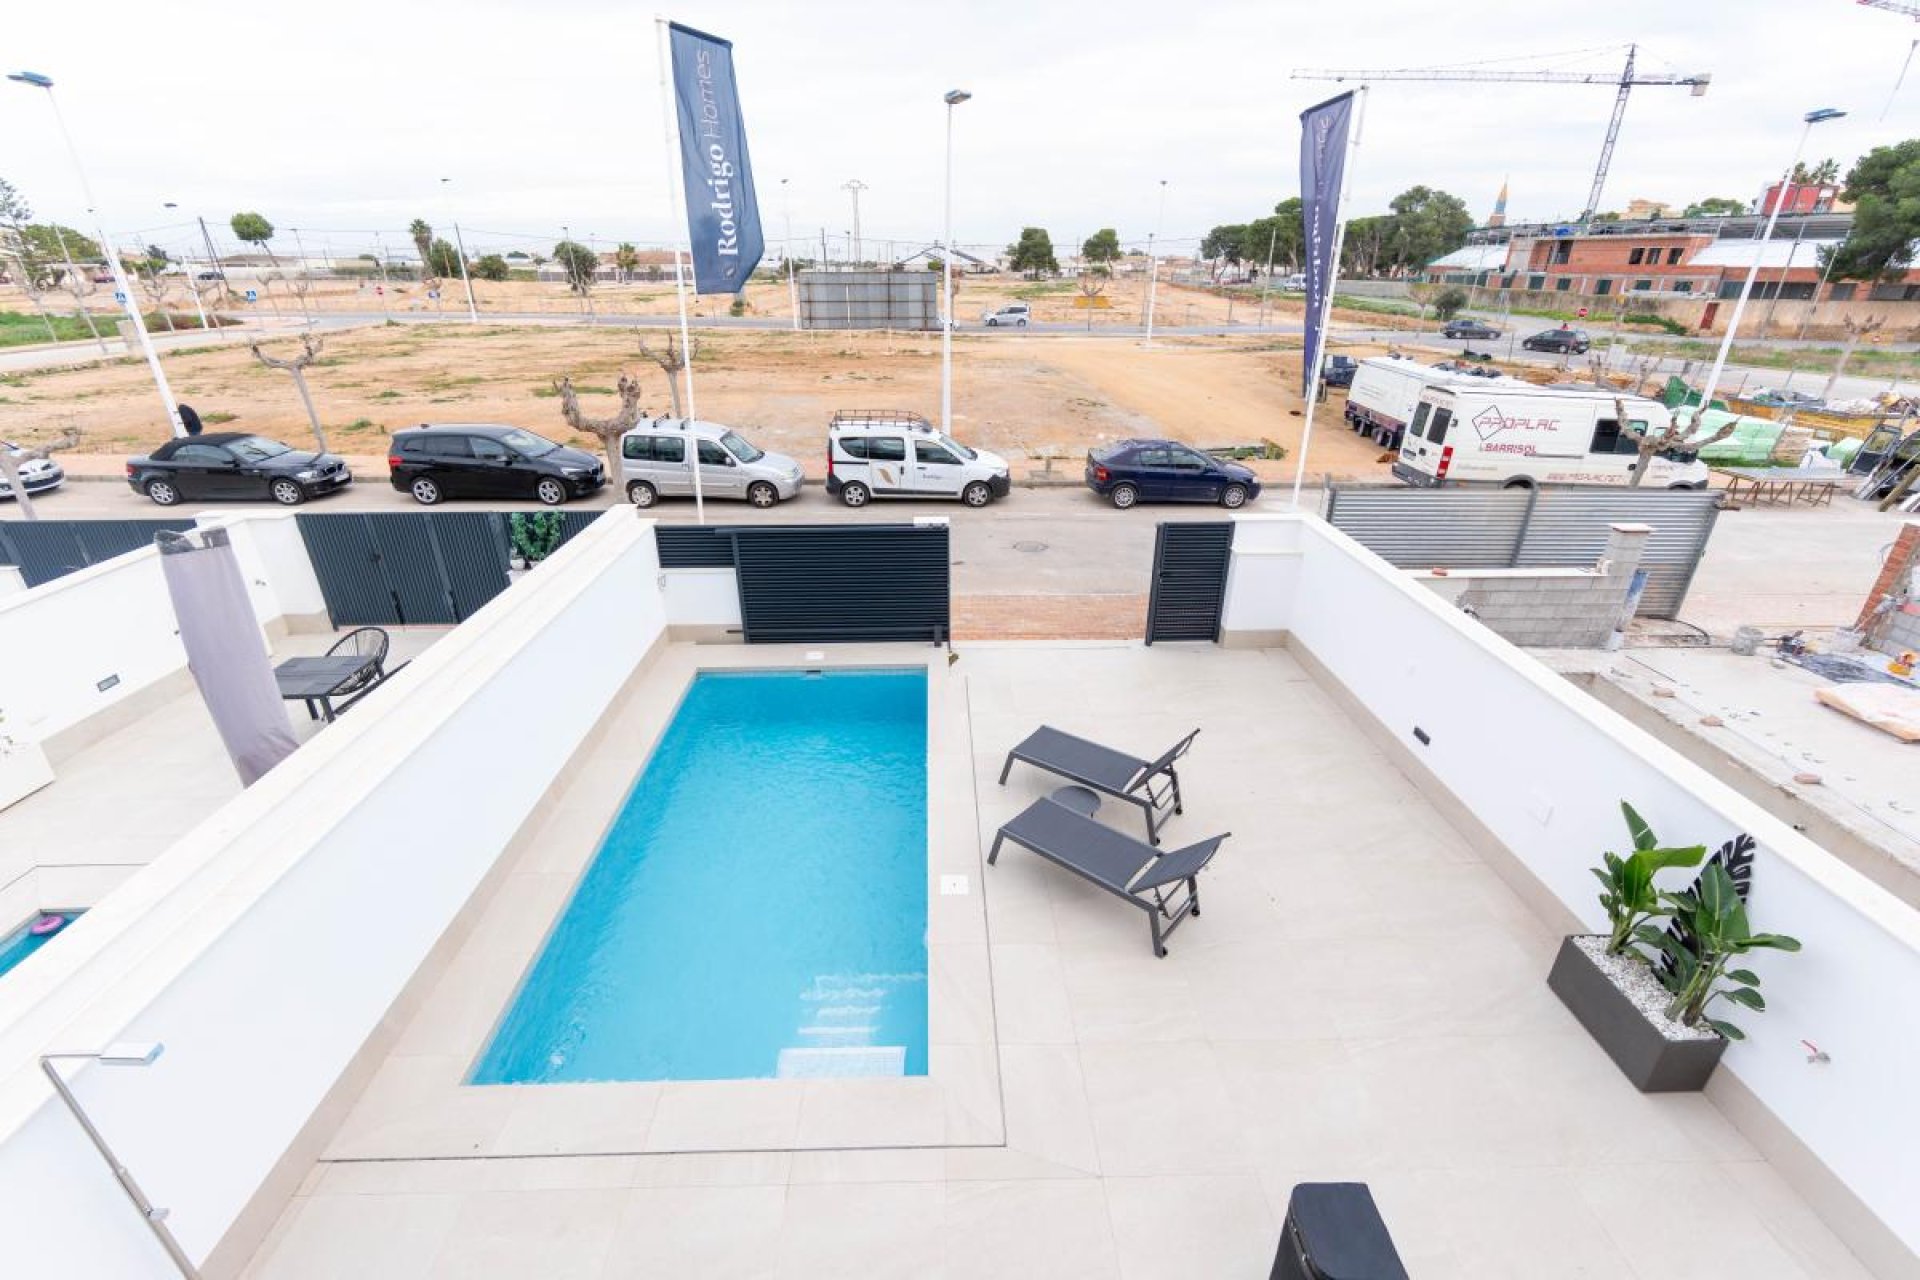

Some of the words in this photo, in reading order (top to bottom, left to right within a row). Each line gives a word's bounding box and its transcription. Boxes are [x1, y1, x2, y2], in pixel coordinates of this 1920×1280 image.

[696, 50, 721, 139] Homes
[708, 144, 738, 257] Rodrigo
[1477, 415, 1561, 432] PROPLAC
[1484, 442, 1537, 456] BARRISOL
